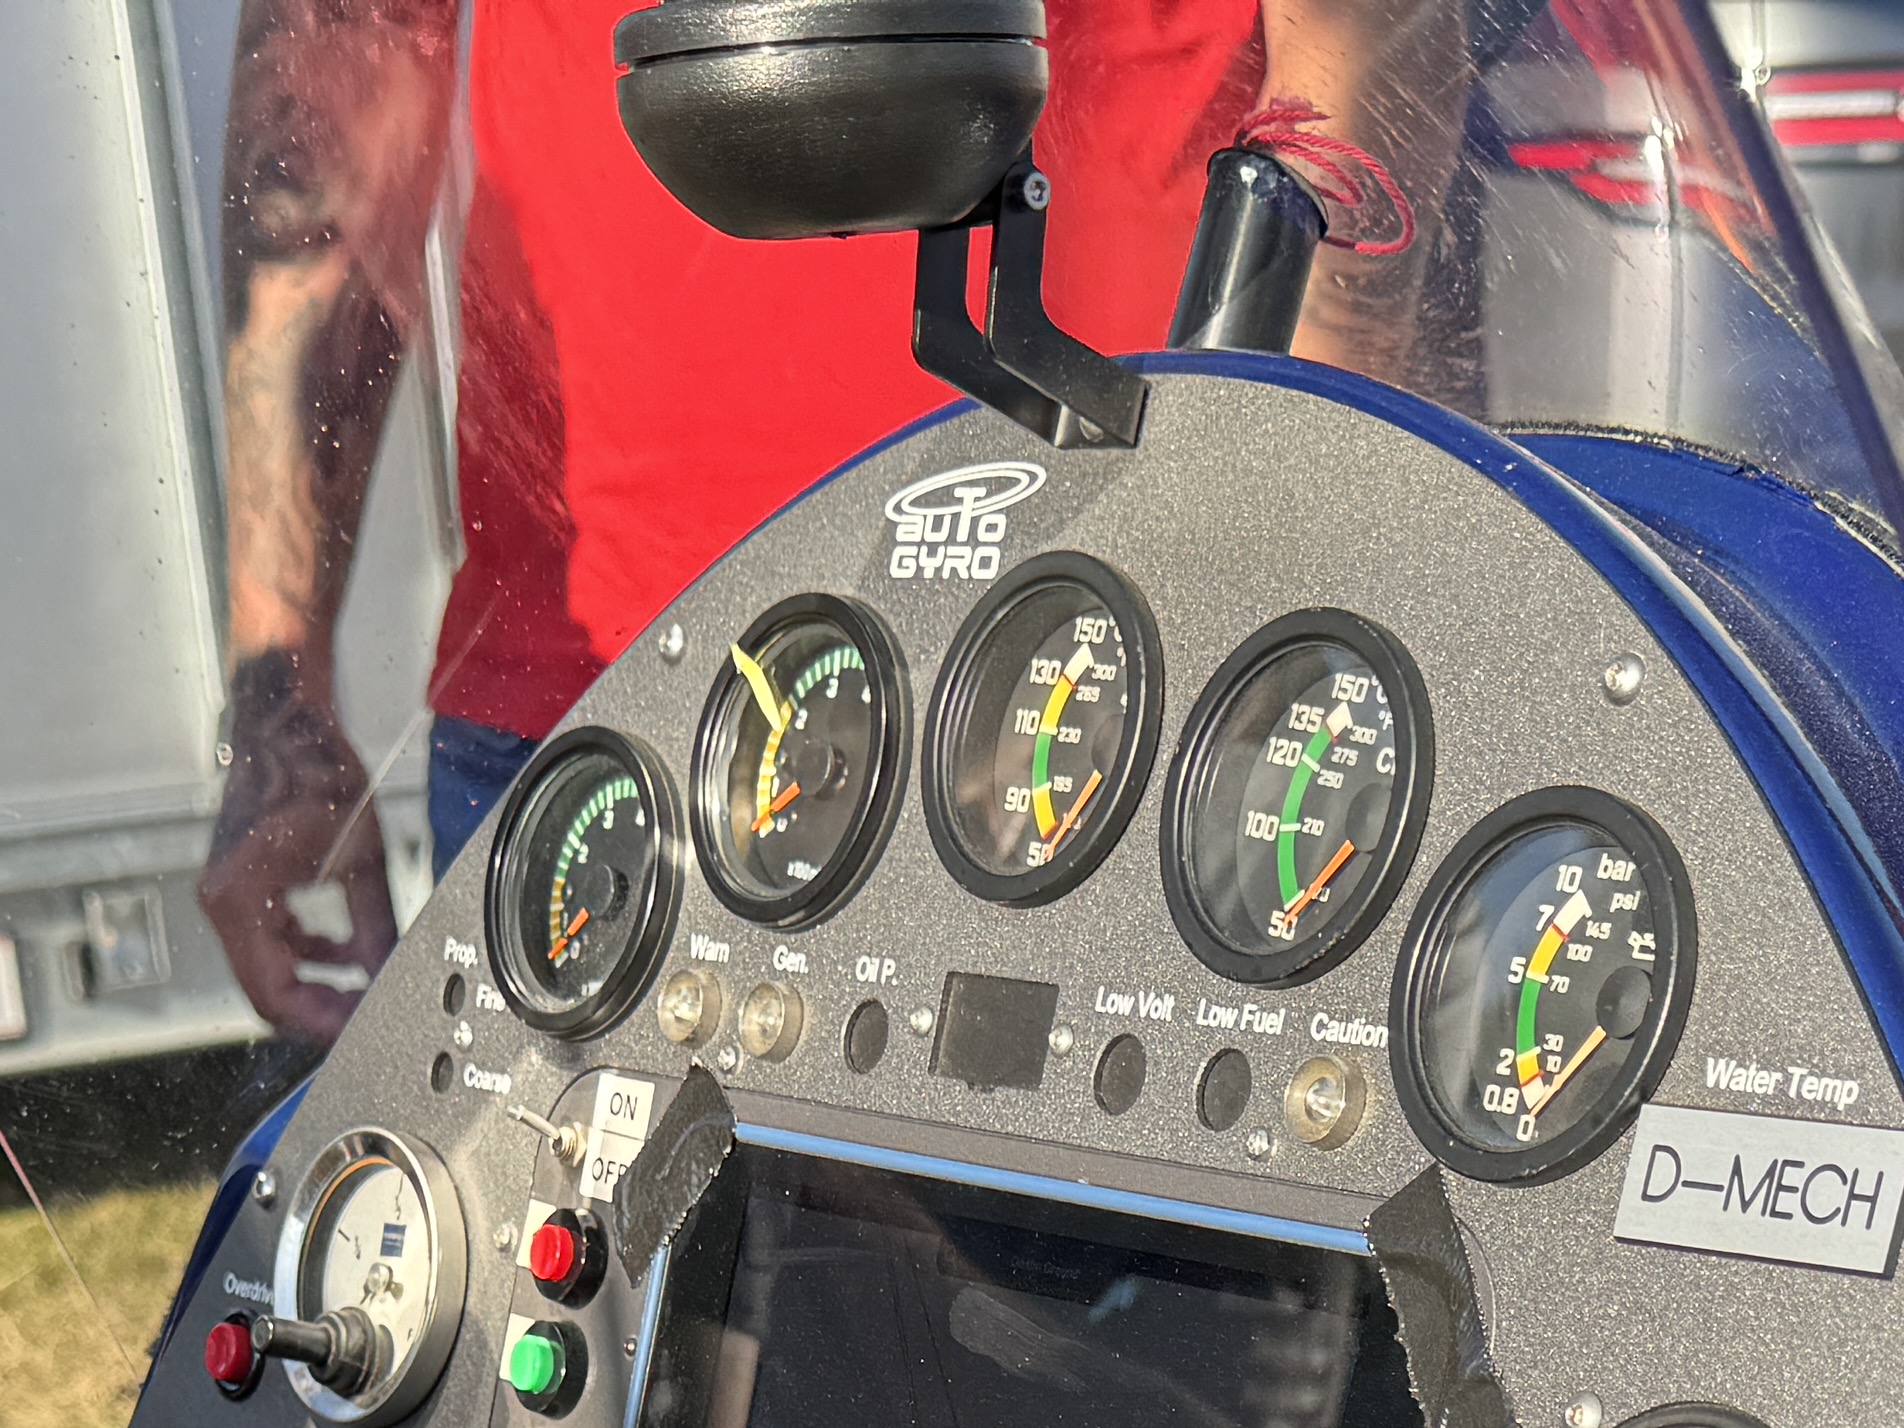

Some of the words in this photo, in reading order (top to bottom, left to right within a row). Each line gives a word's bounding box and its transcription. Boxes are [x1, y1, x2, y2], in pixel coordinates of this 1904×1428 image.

[889, 545, 1001, 580] GYRO
[1074, 617, 1105, 645] 150
[1030, 658, 1062, 687] 130
[1091, 665, 1116, 682] 300
[1331, 673, 1369, 703] 150
[1014, 708, 1041, 736] 110
[1288, 703, 1326, 734] 135
[1057, 727, 1081, 745] 230
[1349, 725, 1377, 745] 300
[1266, 736, 1304, 768] 120
[1331, 746, 1359, 767] 275
[1317, 768, 1345, 789] 250
[1003, 785, 1031, 814] 90
[1245, 810, 1280, 842] 100
[1301, 818, 1325, 837] 210
[1026, 843, 1055, 869] 50
[1597, 854, 1636, 883] bar
[1556, 865, 1583, 893] 10
[1610, 890, 1640, 912] psi
[1268, 911, 1299, 941] 50
[1535, 905, 1554, 931] 7
[1585, 921, 1612, 940] 145
[444, 936, 479, 966] Prop.
[690, 933, 730, 964] Warn
[773, 945, 809, 974] Gen.
[1566, 943, 1593, 962] 100
[855, 954, 881, 982] Oil
[882, 956, 898, 985] P.
[1508, 957, 1526, 984] 5
[1550, 976, 1570, 993] 70
[1096, 984, 1135, 1015] Low
[1137, 991, 1176, 1023] Volt
[1196, 997, 1235, 1029] Low
[1239, 1003, 1285, 1036] Fuel
[1310, 1012, 1389, 1050] Caution
[1543, 1034, 1564, 1052] 30
[1496, 1049, 1515, 1076] 2
[1547, 1055, 1562, 1073] 10
[463, 1062, 513, 1094] Coarse
[1706, 1058, 1782, 1098] Water
[1788, 1066, 1860, 1108] Temp
[609, 1091, 638, 1121] ON
[1483, 1084, 1519, 1115] 0.8
[1516, 1113, 1536, 1142] 0
